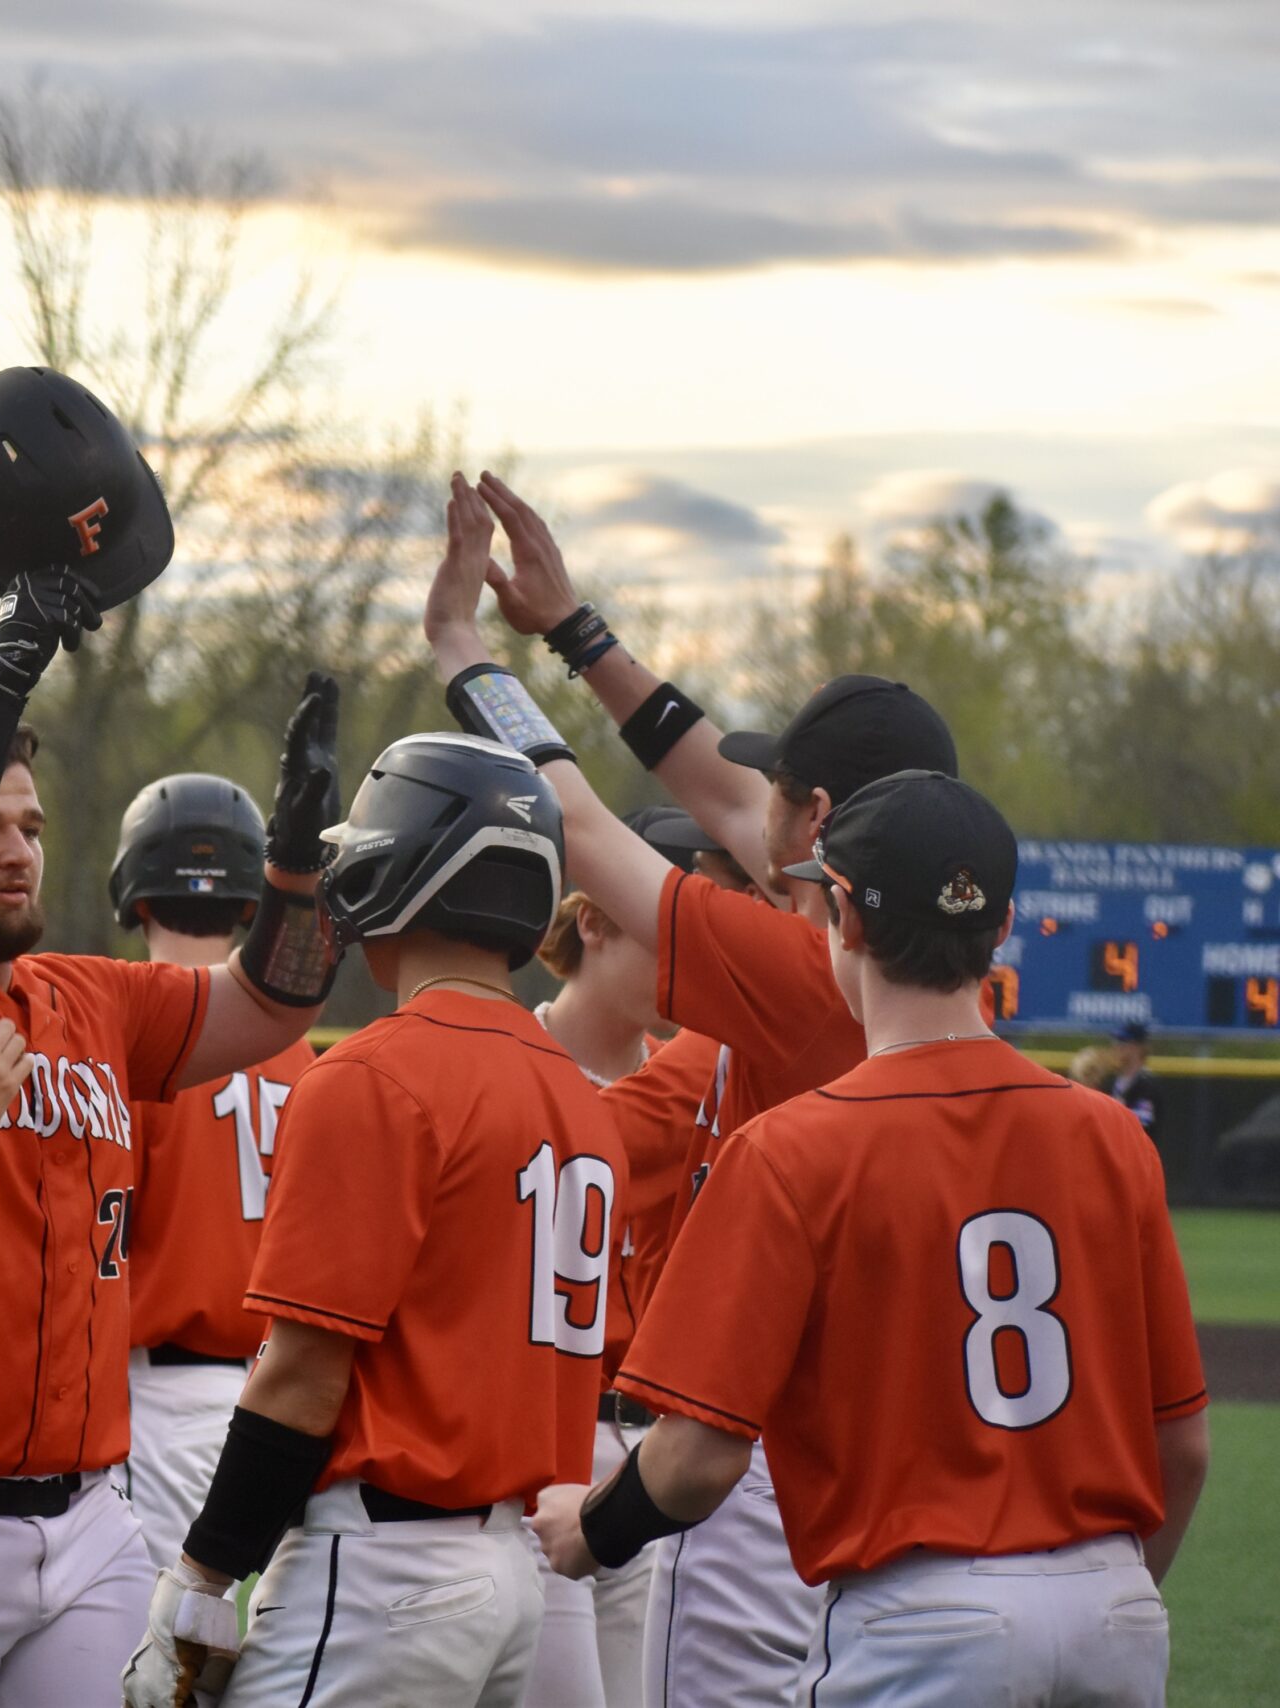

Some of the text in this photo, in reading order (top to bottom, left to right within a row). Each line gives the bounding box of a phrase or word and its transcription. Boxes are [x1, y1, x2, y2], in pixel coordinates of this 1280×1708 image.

[68, 496, 109, 556] F
[355, 837, 395, 852] EASTON
[1144, 896, 1193, 922] OUT
[1104, 941, 1139, 993] 4
[1067, 992, 1152, 1022] INNING
[1246, 976, 1279, 1026] 4
[516, 1139, 615, 1359] 19
[956, 1208, 1073, 1432] 8
